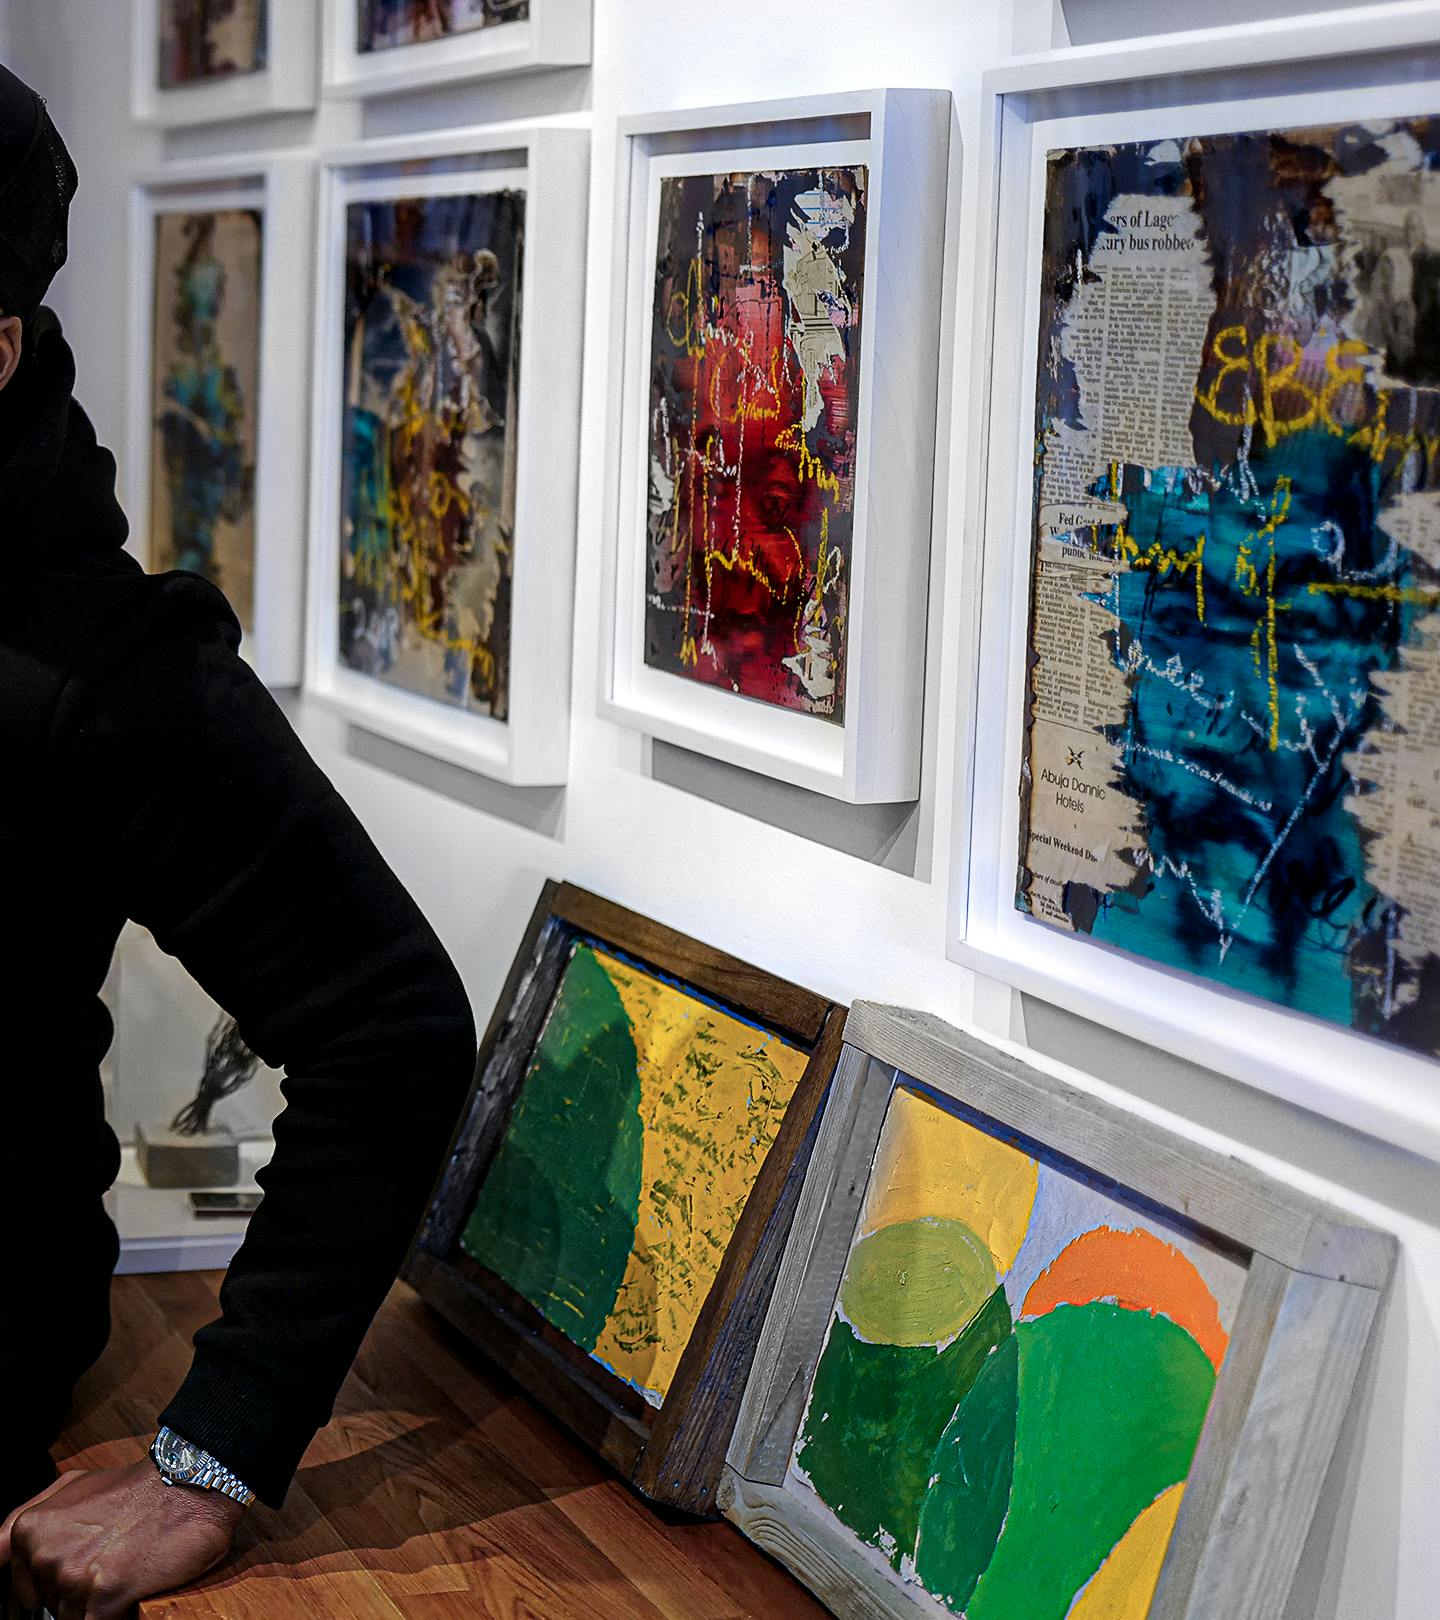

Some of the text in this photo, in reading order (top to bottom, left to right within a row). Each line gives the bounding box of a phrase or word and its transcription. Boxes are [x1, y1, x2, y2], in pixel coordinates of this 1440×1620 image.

[1110, 215, 1127, 227] ers
[1130, 211, 1144, 227] of
[1099, 235, 1127, 254] ury
[1129, 234, 1149, 251] bus
[1059, 513, 1074, 525] Fed
[1041, 768, 1106, 800] Abuja Dannic
[1056, 792, 1085, 813] Hotels
[1053, 837, 1083, 857] Weekend
